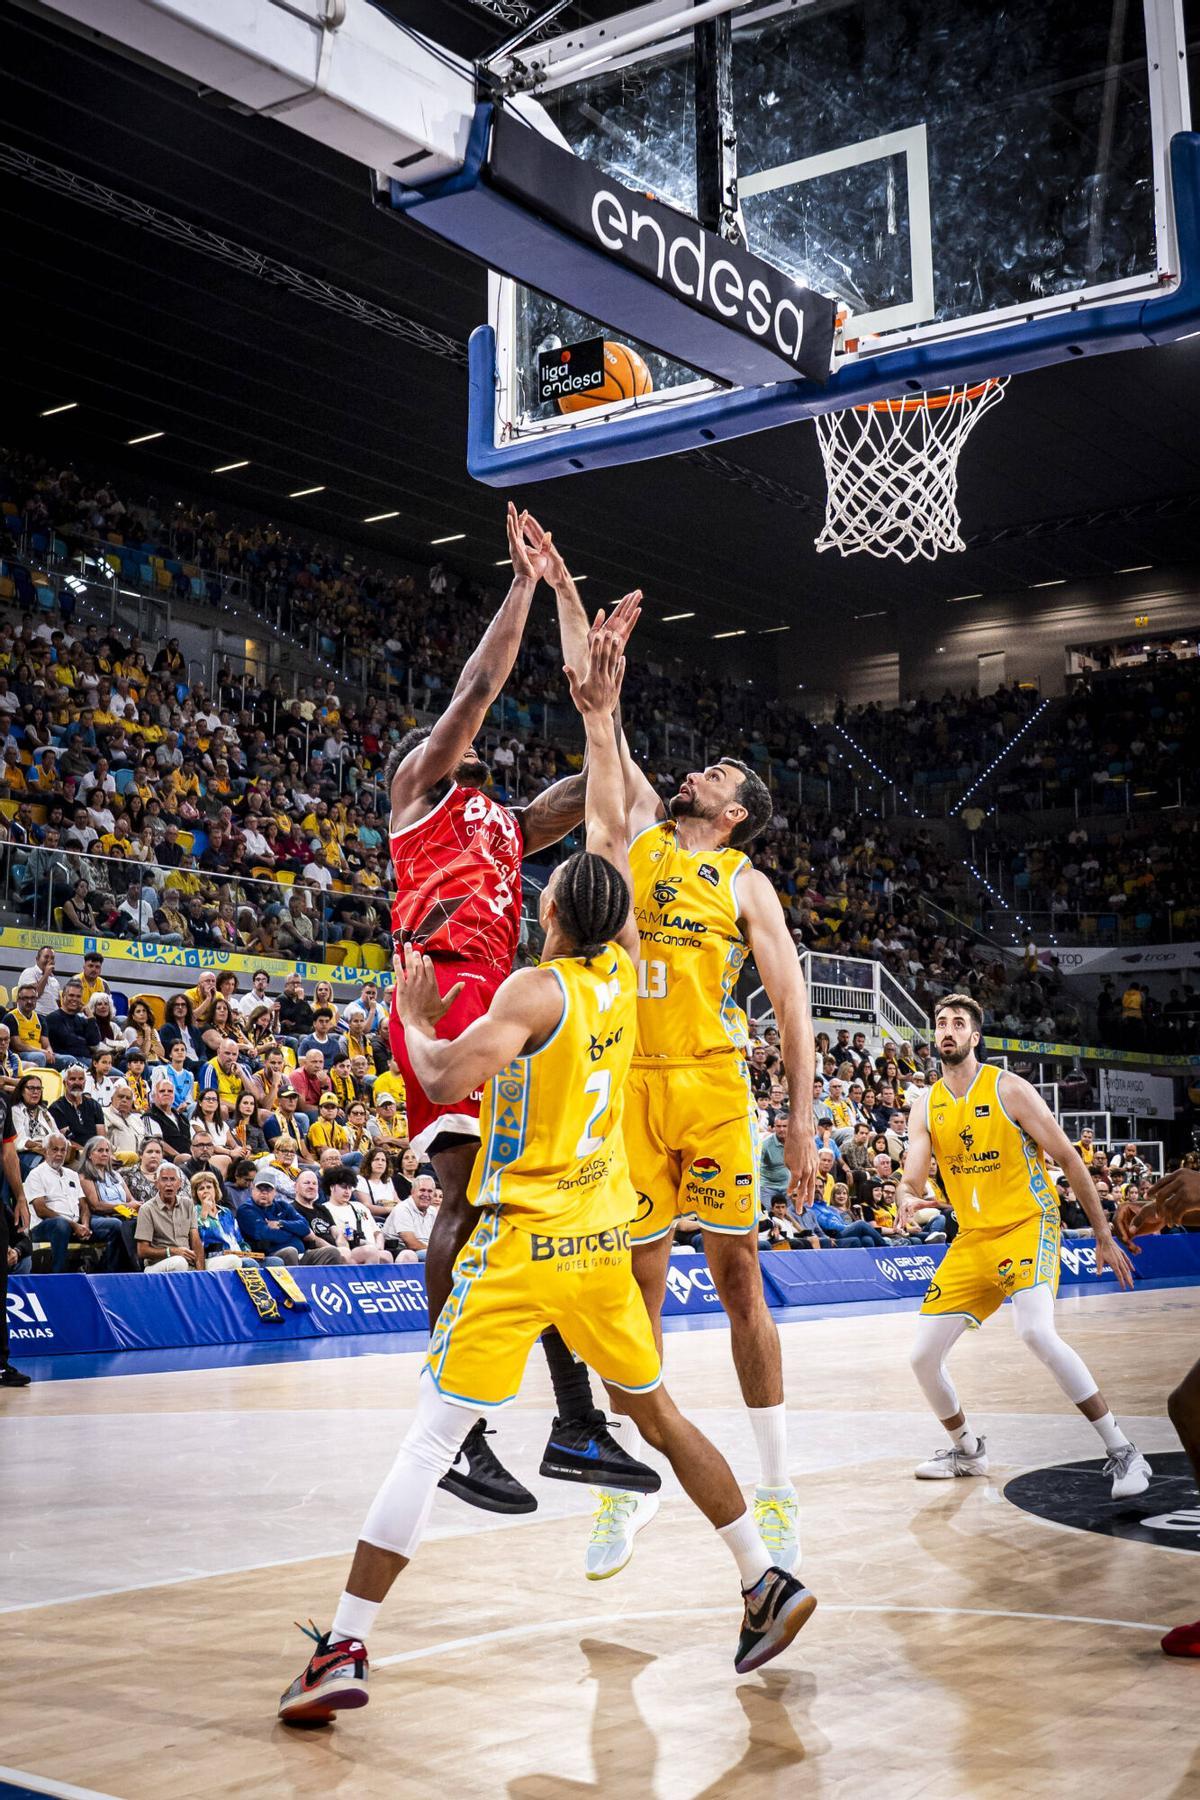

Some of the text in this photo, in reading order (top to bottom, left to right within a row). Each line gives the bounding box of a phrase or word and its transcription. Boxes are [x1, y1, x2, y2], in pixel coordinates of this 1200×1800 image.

[591, 190, 804, 362] endesa
[541, 363, 569, 383] liga
[541, 370, 602, 397] endesa
[633, 906, 707, 933] AMLAND
[638, 929, 702, 948] anCanaria
[1057, 952, 1083, 965] trop
[637, 959, 667, 998] 13
[703, 1195, 725, 1210] Mar
[557, 1259, 588, 1273] HOTEL
[893, 1255, 935, 1267] GRUPO
[348, 1279, 424, 1295] GRUPO
[6, 1292, 48, 1323] RI
[358, 1292, 429, 1315] soliti
[9, 1328, 54, 1339] ARIAS
